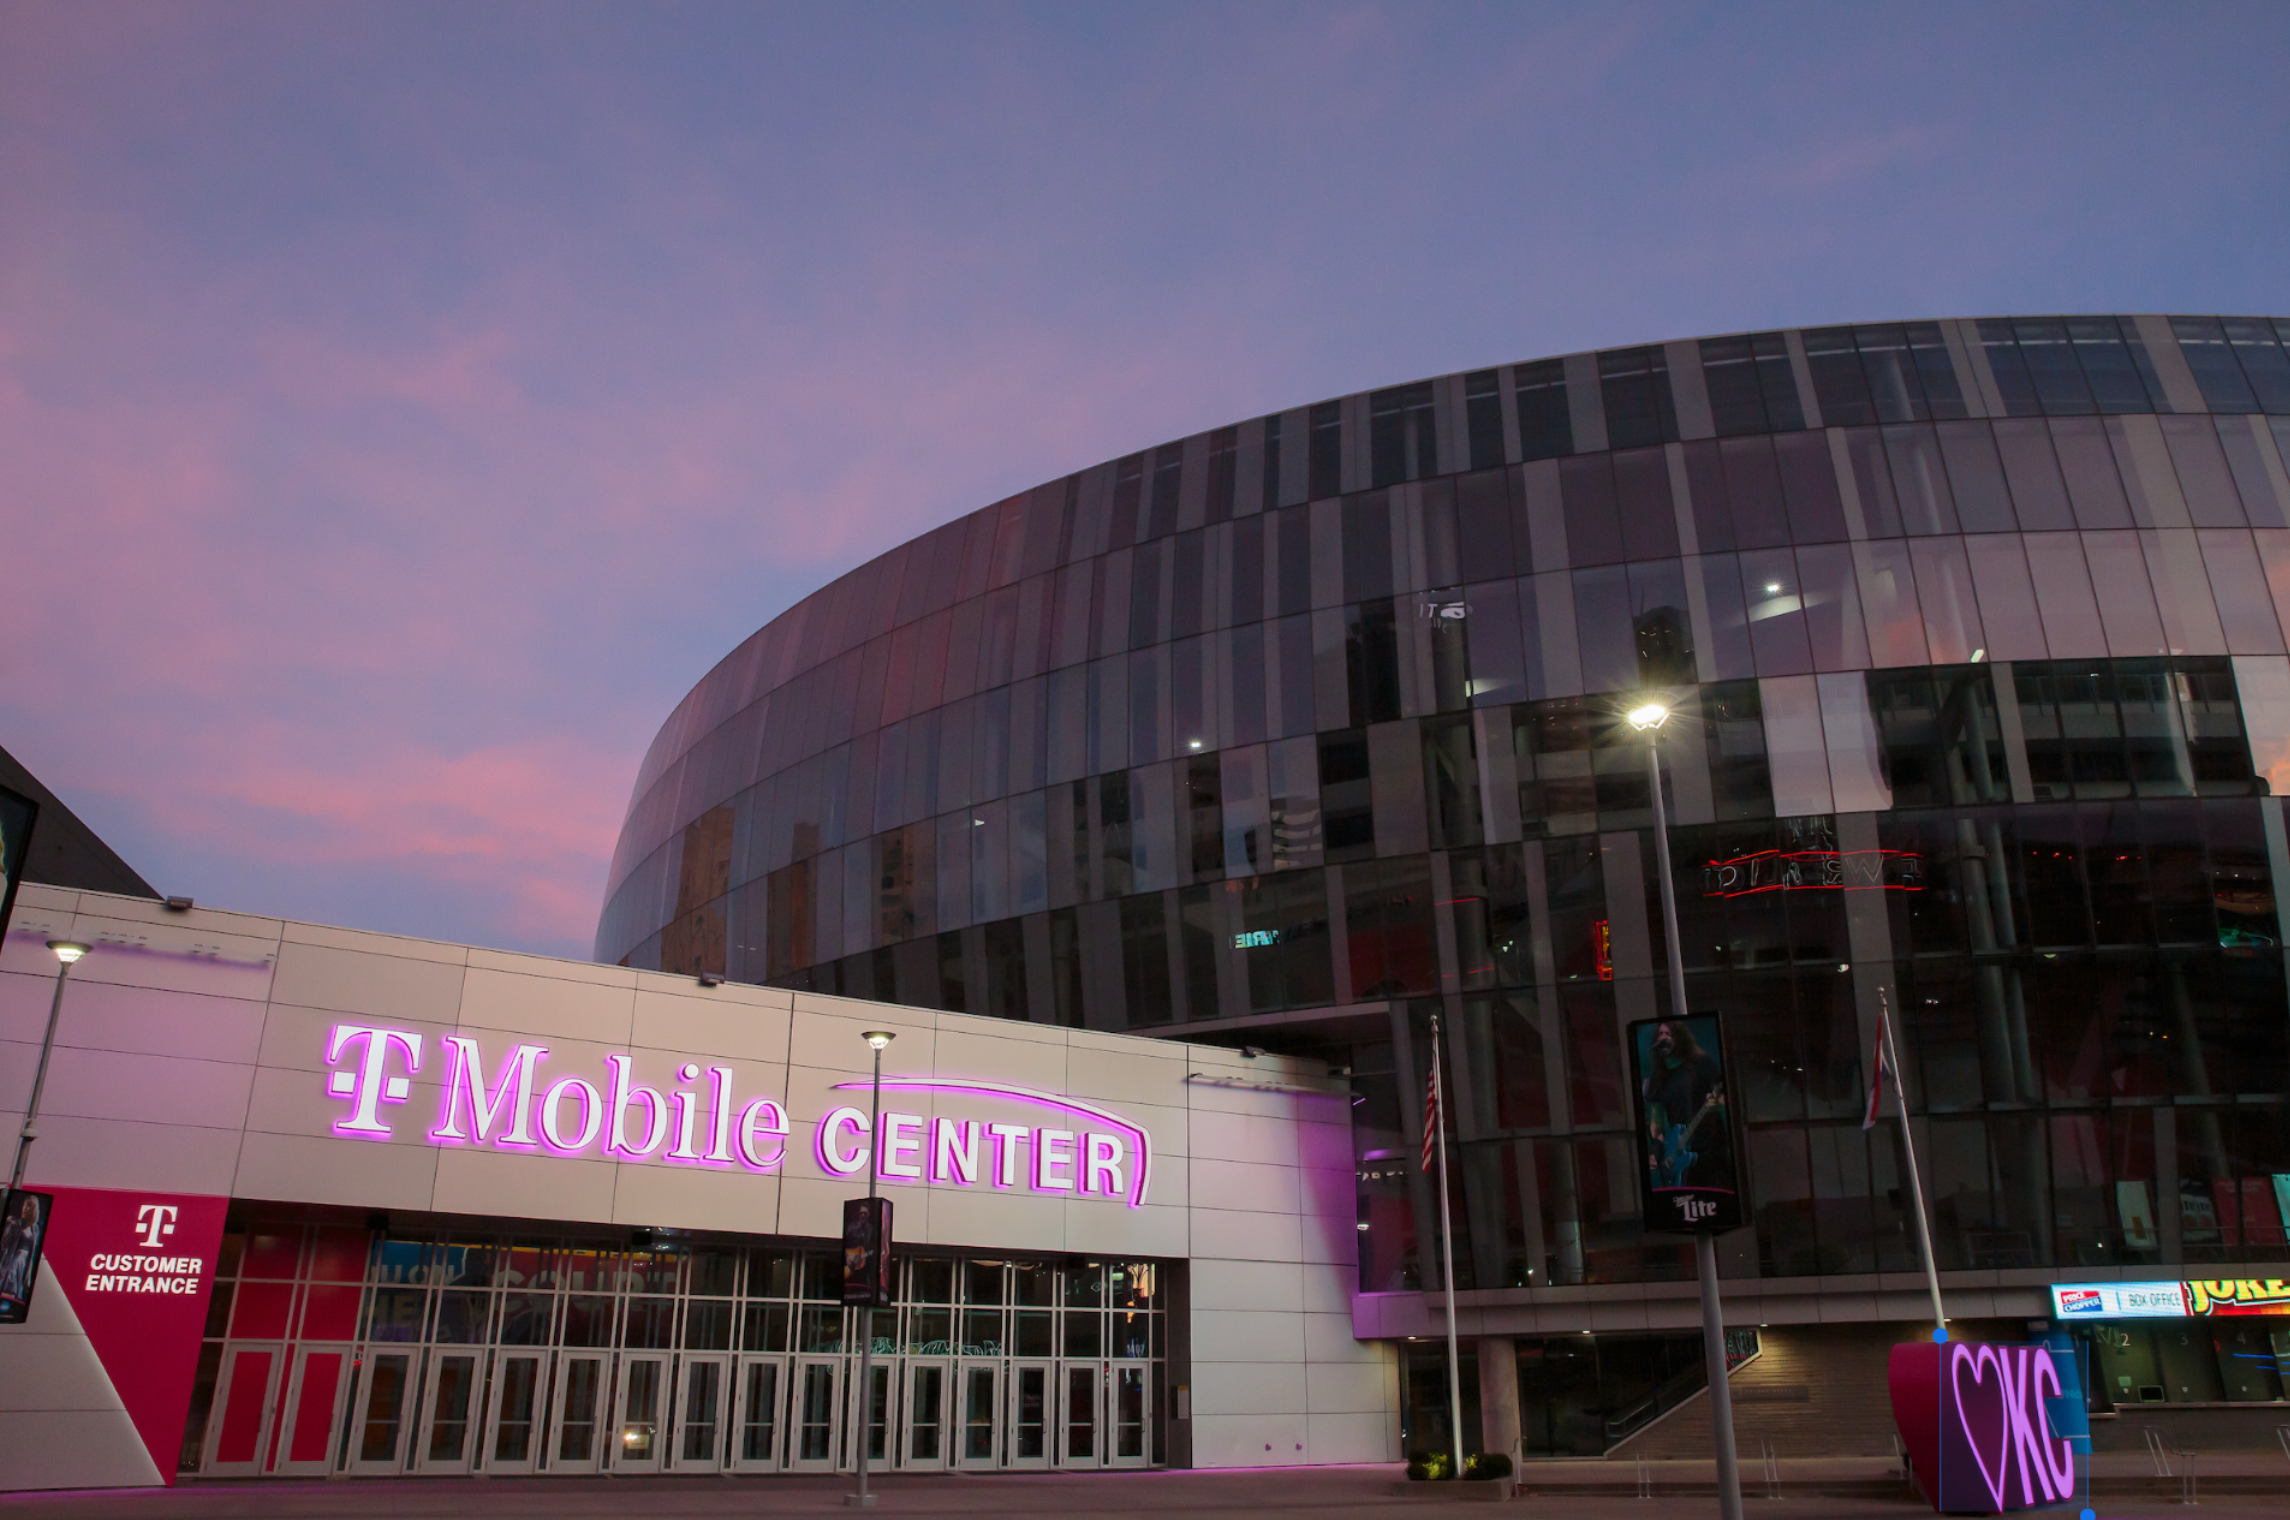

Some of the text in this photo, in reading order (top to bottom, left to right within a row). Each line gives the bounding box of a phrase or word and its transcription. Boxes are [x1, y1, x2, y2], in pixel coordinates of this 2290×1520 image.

[328, 1025, 1126, 1194] T Mobile CENTER
[1683, 1200, 1717, 1222] Lite
[135, 1204, 178, 1248] T
[90, 1253, 203, 1274] CUSTOMER
[84, 1274, 199, 1295] ENTRANCE
[2062, 1291, 2086, 1303] PRICE
[2064, 1297, 2102, 1312] CHOPPER
[2128, 1292, 2181, 1307] BOX OFFICE
[2119, 1333, 2131, 1347] 2
[1999, 1347, 2075, 1506] KC
